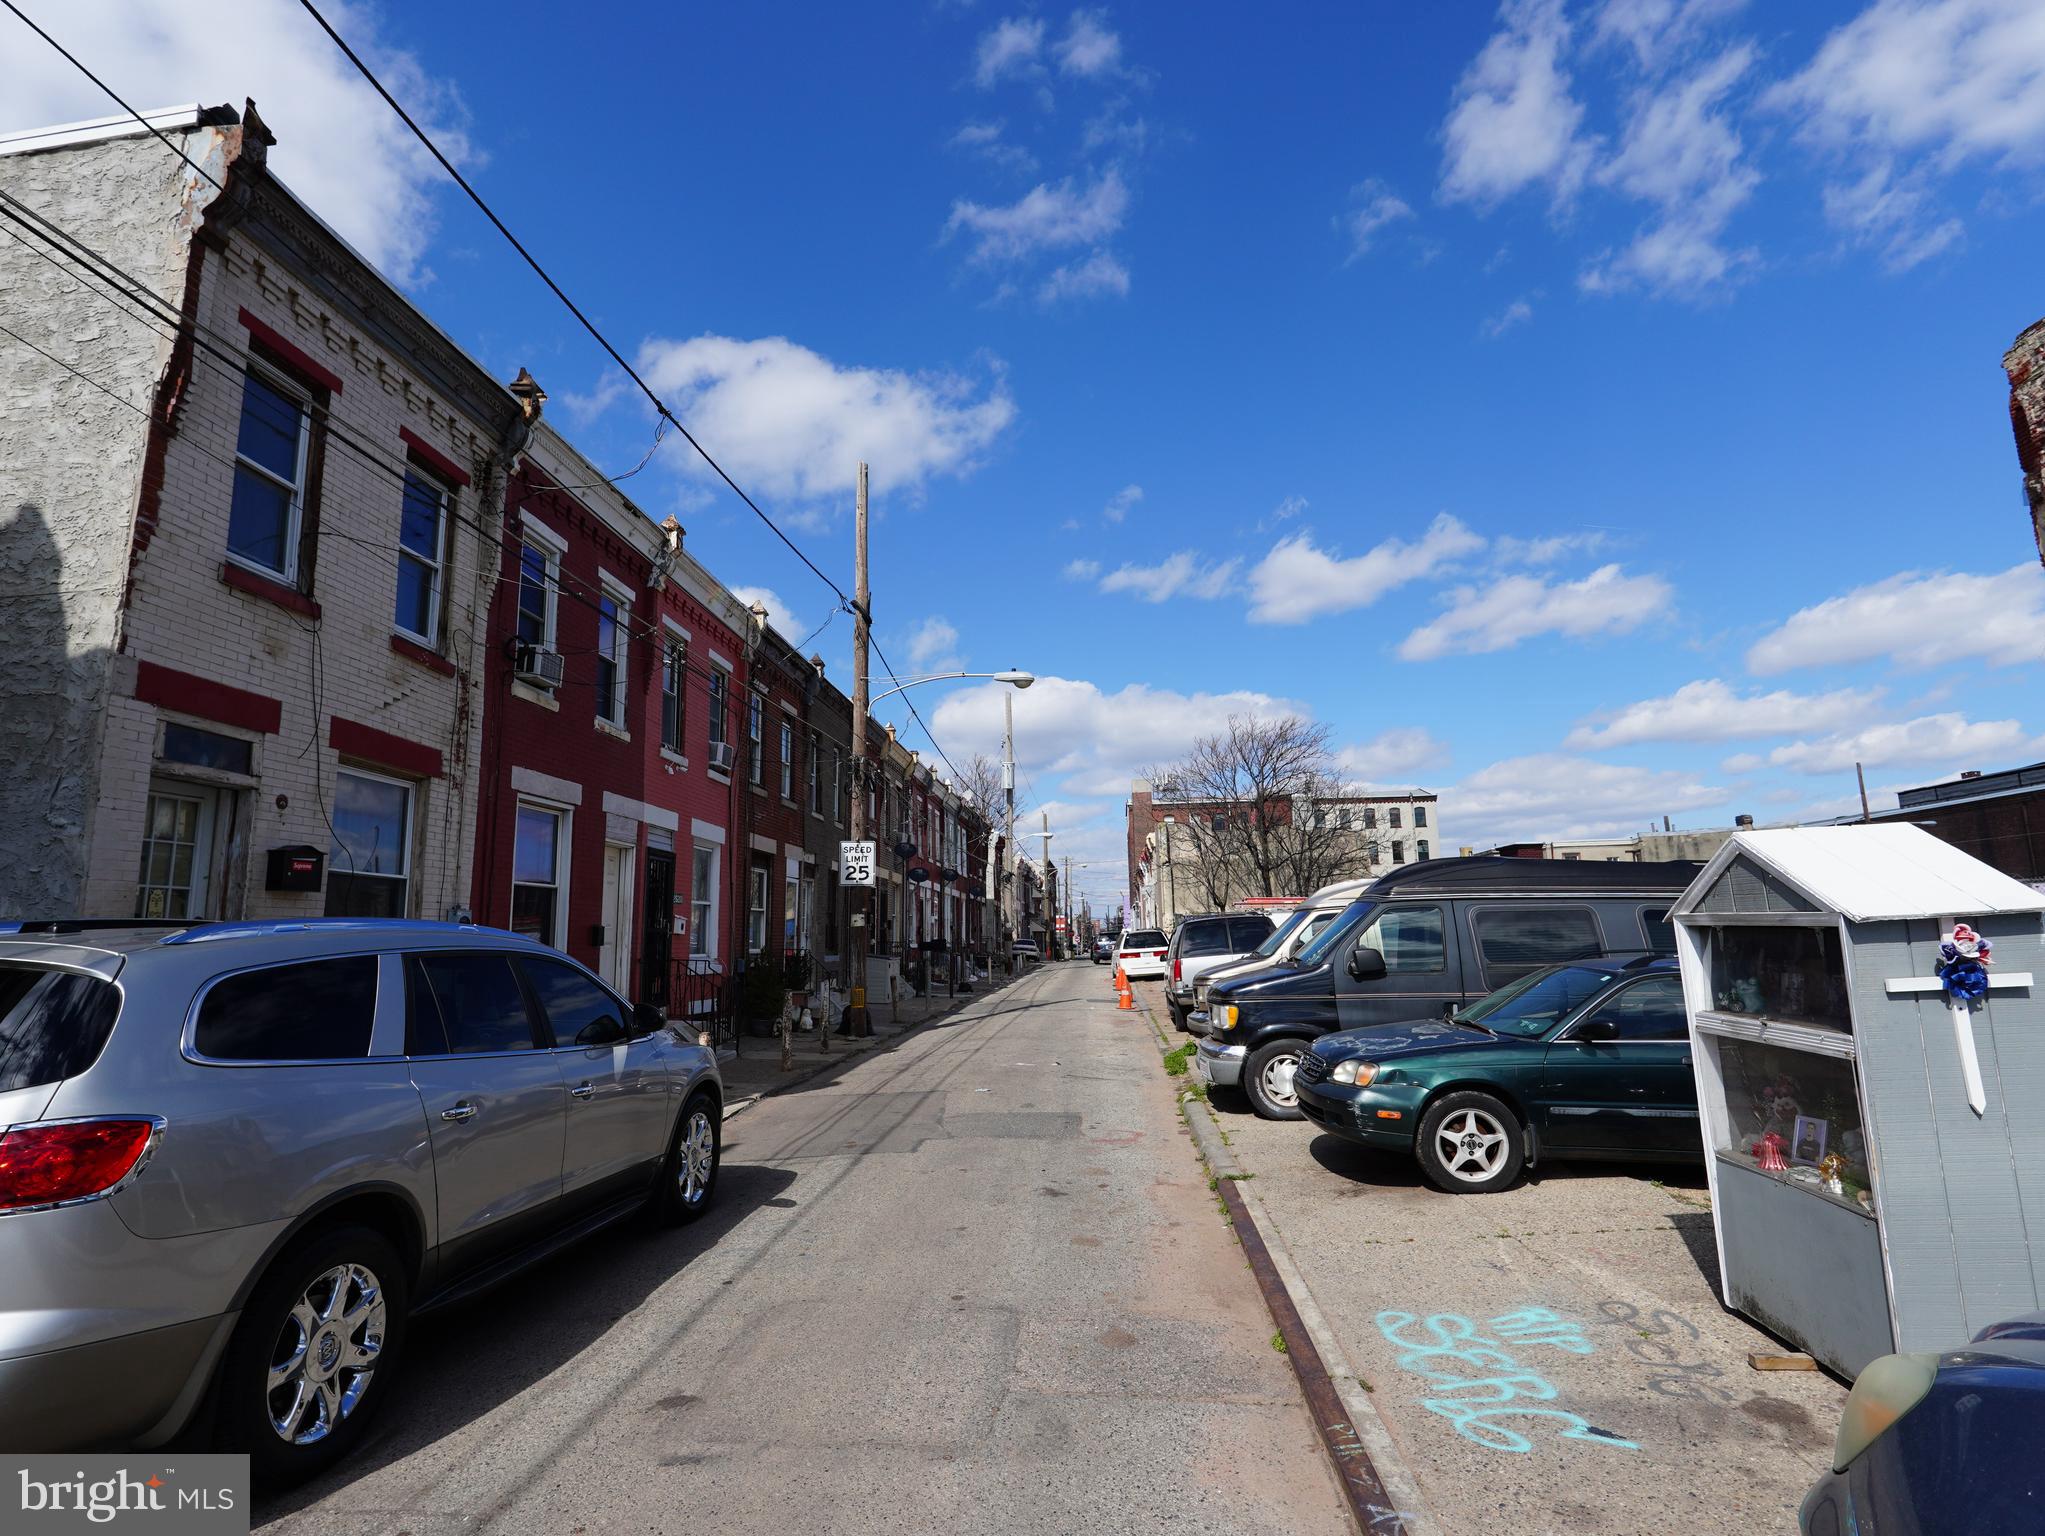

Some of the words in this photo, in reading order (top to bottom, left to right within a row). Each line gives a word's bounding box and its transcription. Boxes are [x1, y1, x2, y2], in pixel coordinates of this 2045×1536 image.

[843, 846, 872, 854] SPEED
[846, 855, 869, 863] LIMIT
[845, 865, 869, 880] 25
